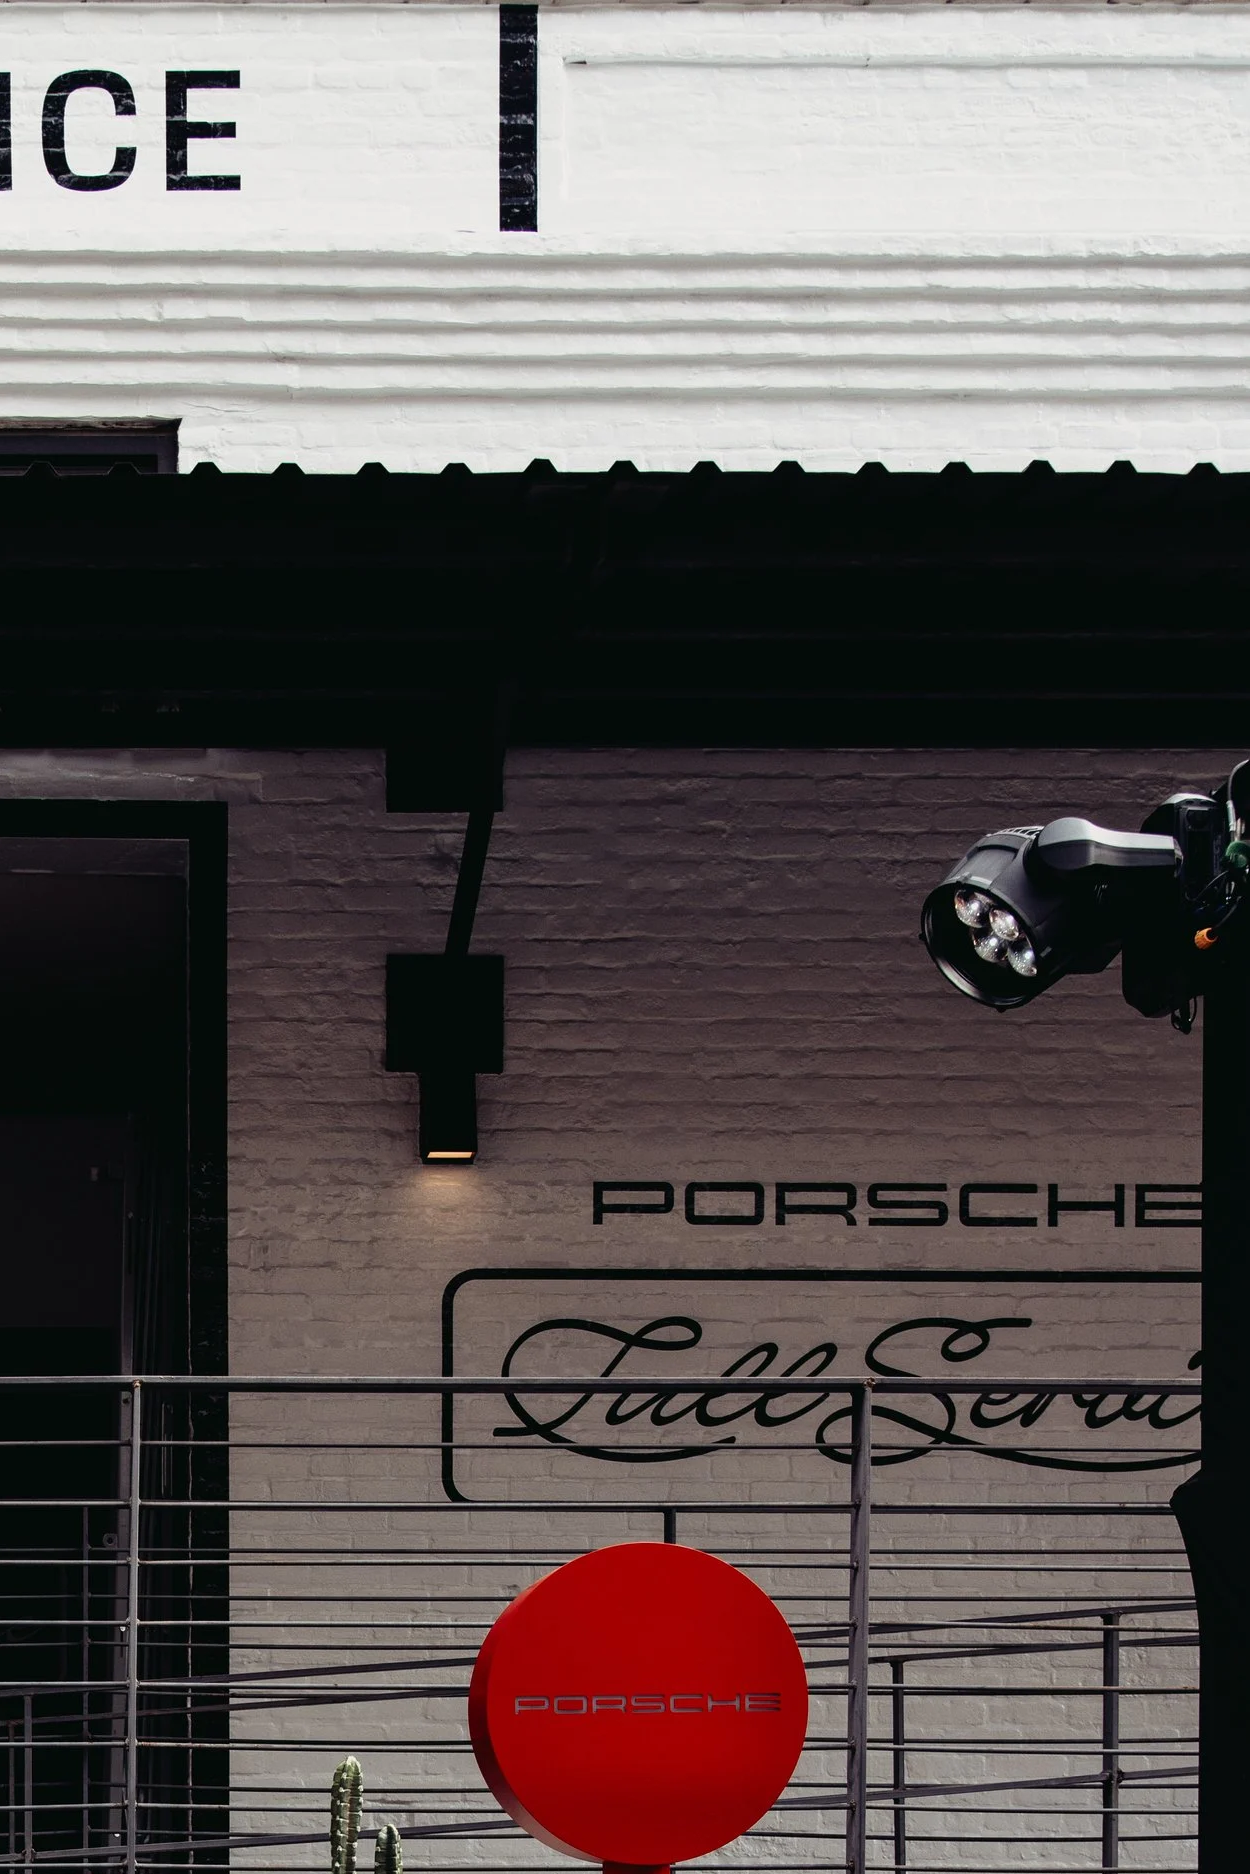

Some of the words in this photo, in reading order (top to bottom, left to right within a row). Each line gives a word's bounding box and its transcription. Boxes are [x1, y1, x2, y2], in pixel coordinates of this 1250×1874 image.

[592, 1181, 1202, 1228] PORSCHE
[493, 1316, 838, 1463] Full
[816, 1316, 1202, 1472] Servi
[514, 1692, 781, 1715] PORSCHE
